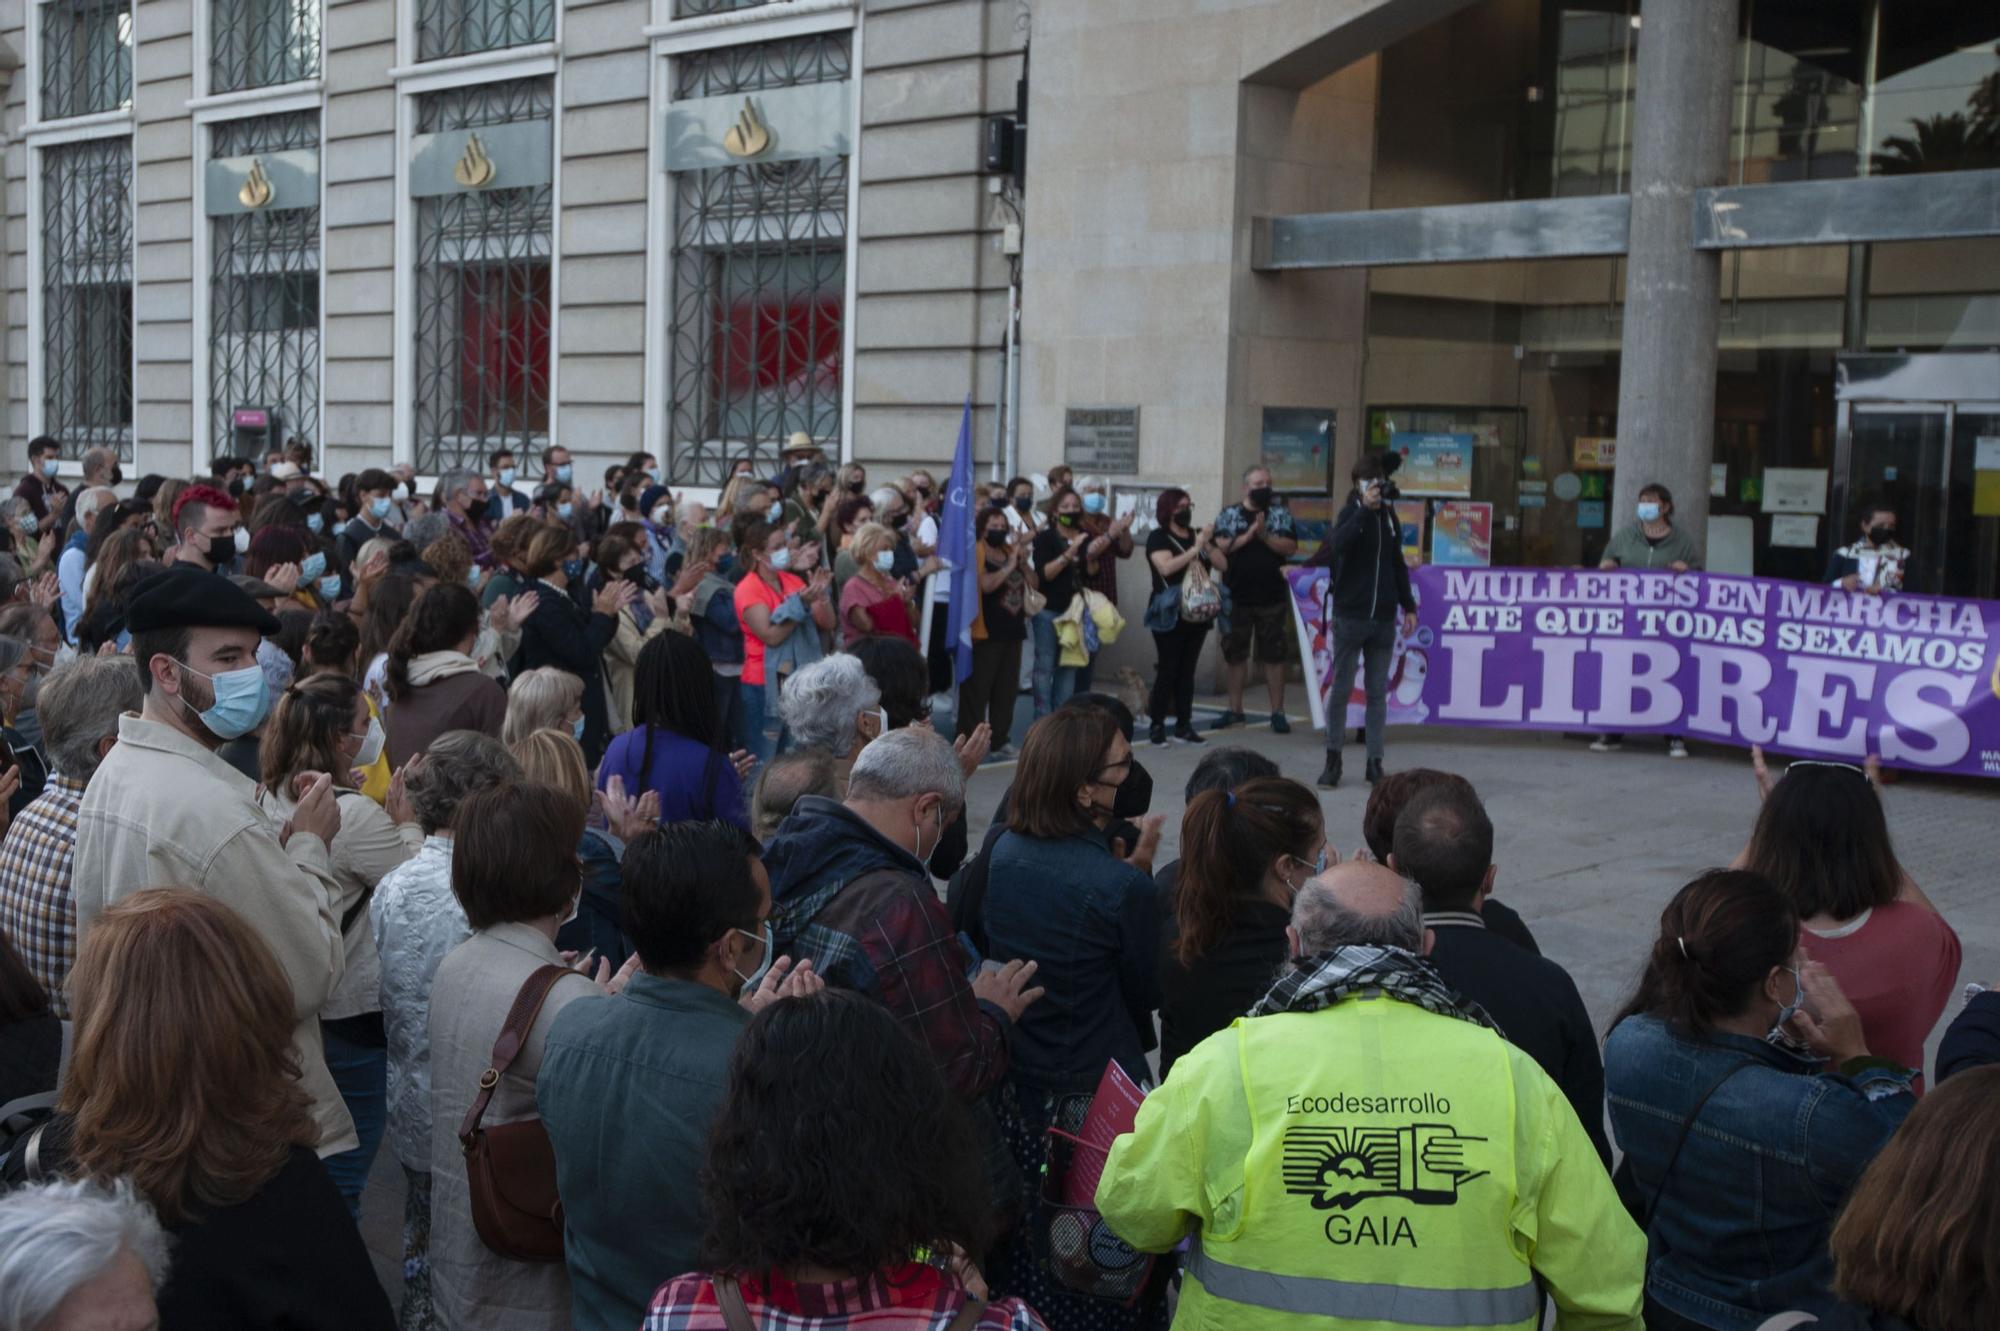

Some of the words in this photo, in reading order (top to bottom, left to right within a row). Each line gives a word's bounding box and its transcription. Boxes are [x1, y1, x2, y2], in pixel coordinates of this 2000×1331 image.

[1441, 599, 1522, 632] ATÉ
[1535, 607, 1624, 635] QUE
[1638, 609, 1765, 647] TODAS
[1777, 621, 1986, 671] SEXAMOS
[1444, 570, 1700, 608] MULLERES
[1705, 578, 1771, 615] EN
[1777, 584, 1988, 639] MARCHA
[1438, 634, 1977, 766] LIBRES
[1286, 1092, 1451, 1115] Ecodesarrollo
[1324, 1214, 1418, 1248] GAIA
